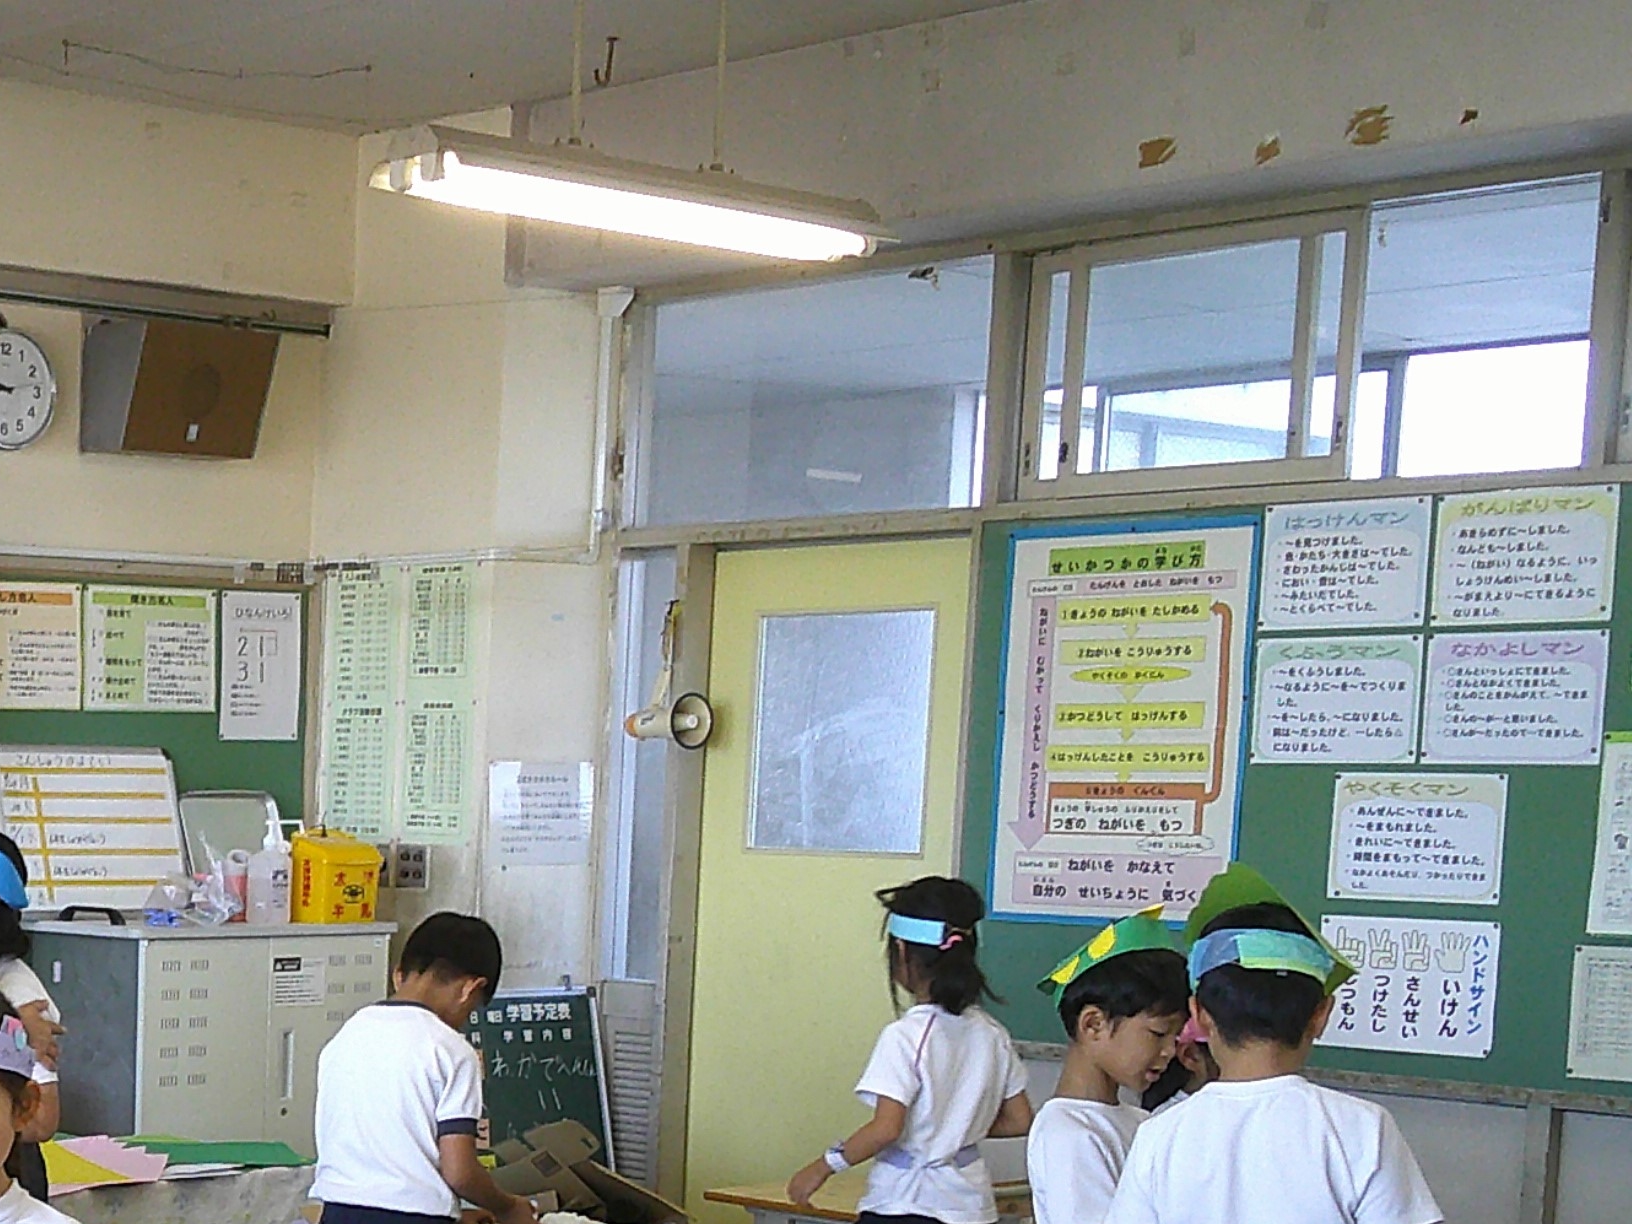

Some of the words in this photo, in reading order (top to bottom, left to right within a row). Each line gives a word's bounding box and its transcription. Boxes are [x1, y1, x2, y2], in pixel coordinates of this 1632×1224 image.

[0, 342, 12, 356] 12
[19, 349, 24, 362] 1
[28, 365, 37, 378] 2
[32, 386, 41, 399] 3
[27, 405, 36, 419] 4
[0, 422, 9, 436] 6
[15, 418, 24, 432] 5
[1460, 496, 1597, 516] がんばりマン
[1284, 511, 1410, 530] はっけんマン
[1051, 552, 1203, 574] せいかつかの学び方
[237, 635, 248, 657] 2
[1279, 644, 1401, 660] くふうマン
[1450, 641, 1585, 658] なかよしマン
[237, 660, 249, 682] 3
[1343, 780, 1470, 797] やくそくマン
[1052, 817, 1087, 831] つぎの
[1098, 817, 1147, 832] ねがいを
[1159, 819, 1184, 832] もつ
[1067, 859, 1115, 872] ねがいを
[1126, 861, 1176, 875] かなえて
[1032, 884, 1067, 898] 自分の
[1078, 886, 1150, 901] せいちょうに
[1465, 934, 1490, 1036] ハンドサイン
[506, 1002, 572, 1023] 学習予定表
[1370, 974, 1392, 1034] つけたし
[1401, 975, 1422, 1039] さんせい
[1438, 978, 1462, 1038] いけん
